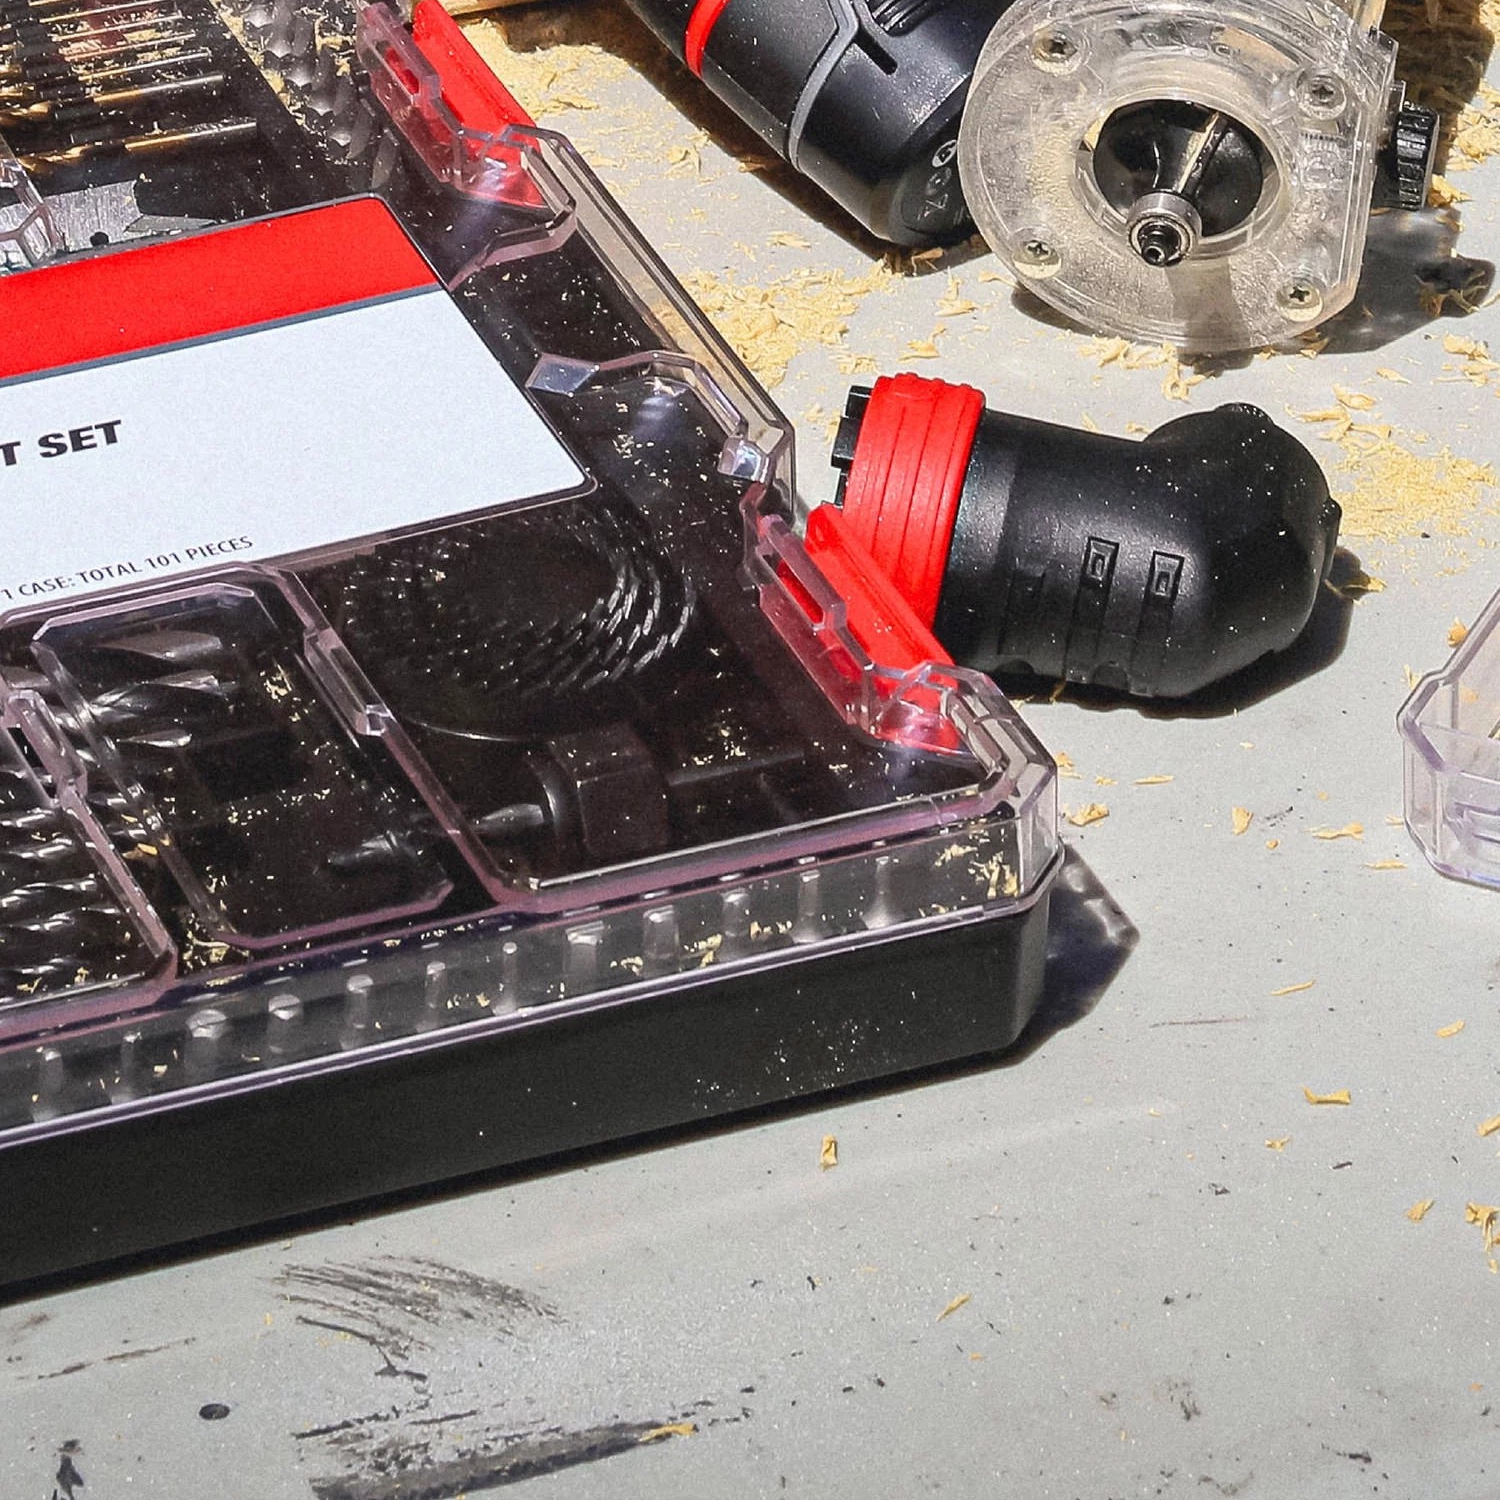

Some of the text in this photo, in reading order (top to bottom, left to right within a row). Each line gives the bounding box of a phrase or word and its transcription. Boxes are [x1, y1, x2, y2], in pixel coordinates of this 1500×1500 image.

[38, 419, 122, 458] SET
[19, 576, 76, 596] CASE:
[76, 561, 143, 584] TOTAL
[144, 552, 182, 569] 101
[185, 535, 254, 561] PIECES
